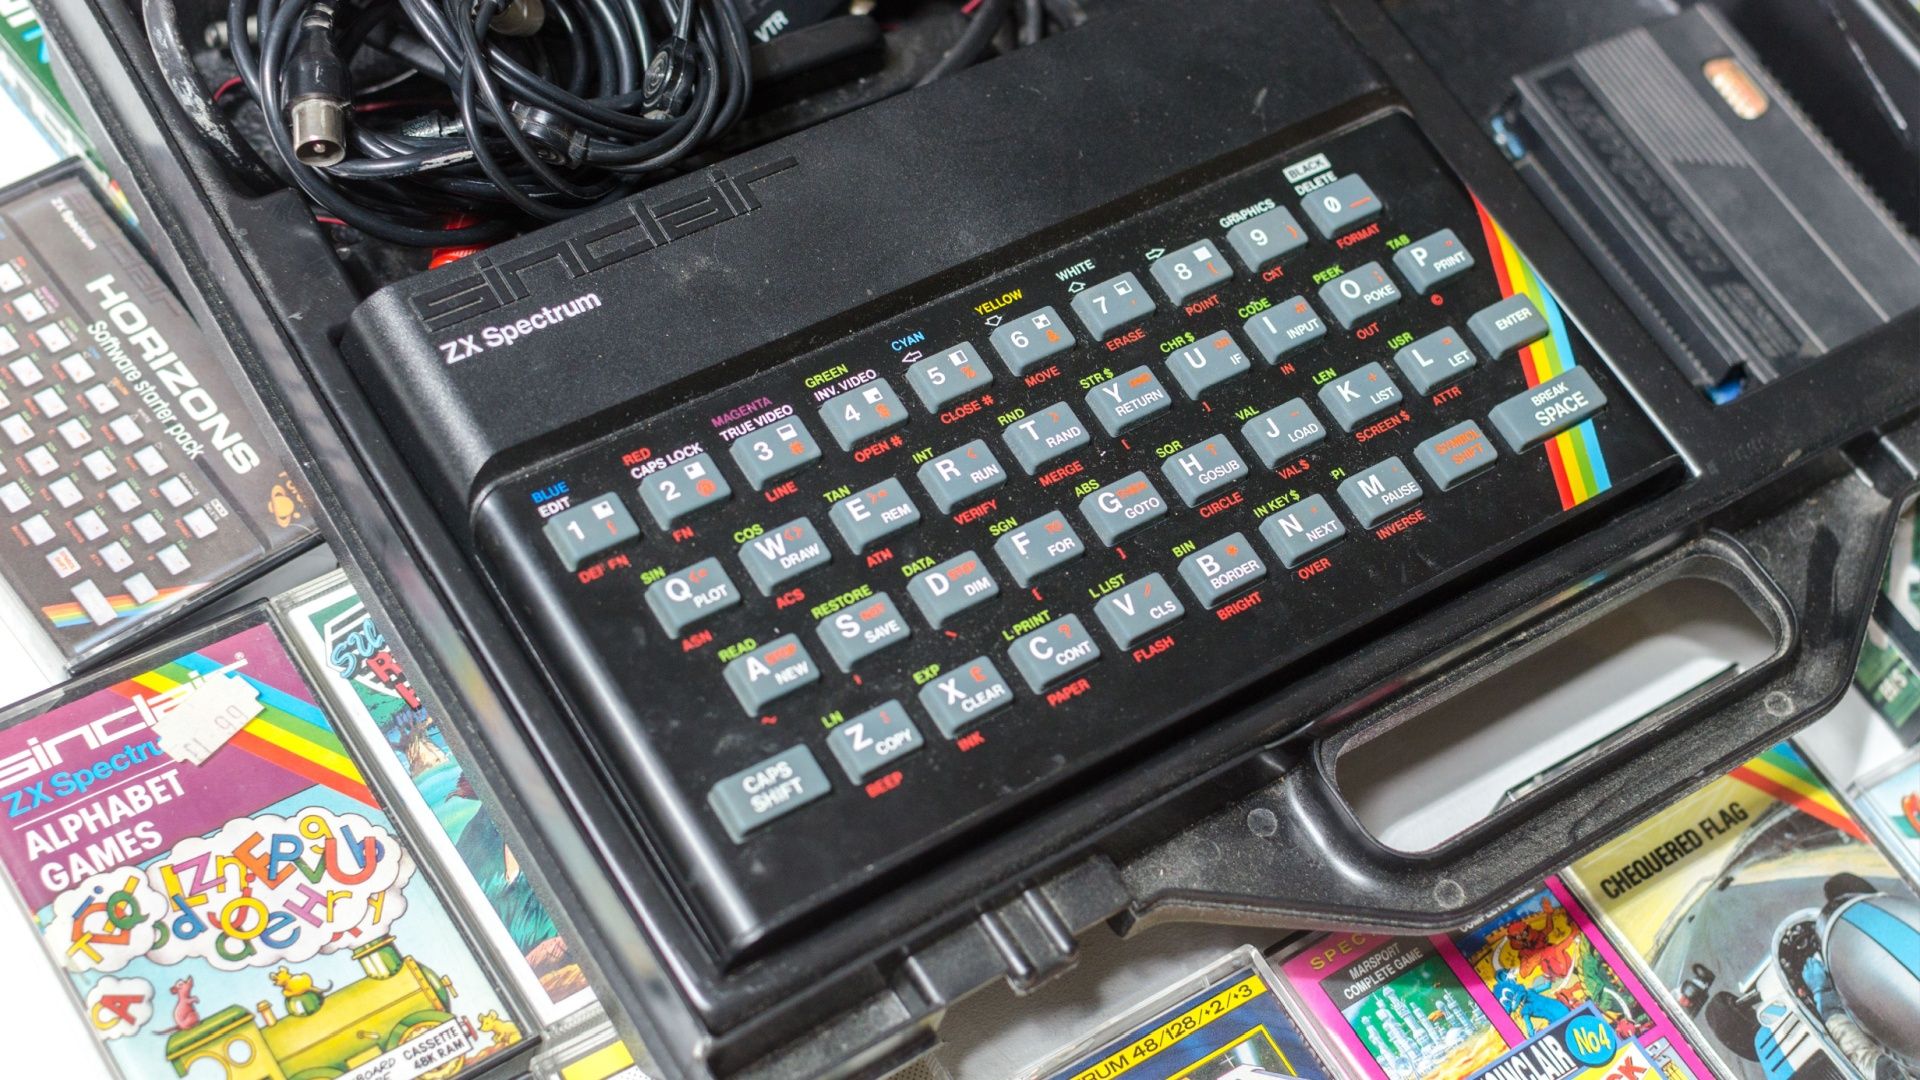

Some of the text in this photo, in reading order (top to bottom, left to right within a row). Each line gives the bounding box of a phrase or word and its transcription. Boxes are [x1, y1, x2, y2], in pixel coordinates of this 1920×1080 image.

[754, 10, 789, 43] VTR
[1287, 158, 1325, 180] BLACK
[1294, 170, 1338, 197] DELETE
[1219, 198, 1276, 228] GRAPHICS
[1250, 228, 1268, 246] 9
[1336, 224, 1381, 250] FORMAT
[1386, 234, 1410, 250] TAB
[1410, 247, 1429, 267] P
[1433, 251, 1467, 273] PRINT
[1055, 258, 1096, 283] WHITE
[1174, 263, 1192, 280] 8
[1262, 266, 1285, 282] CAT
[1312, 264, 1344, 285] PEEK
[974, 289, 1023, 317] YELLOW
[1092, 296, 1109, 315] 7
[1185, 294, 1221, 317] POINT
[1363, 285, 1396, 305] POKE
[1238, 297, 1272, 319] CODE
[1495, 307, 1533, 332] ENTER
[439, 290, 602, 364] ZX Spectrum
[1286, 318, 1320, 340] INPUT
[1356, 322, 1382, 340] OUT
[891, 331, 925, 352] CYAN
[1010, 331, 1029, 348] 6
[1105, 328, 1146, 352] ERASE
[1159, 336, 1183, 354] CHR
[1387, 331, 1414, 350] USR
[1183, 347, 1207, 369] U
[1411, 349, 1434, 368] L
[1448, 350, 1470, 367] LET
[85, 273, 261, 474] HORIZONS
[804, 364, 848, 389] GREEN
[840, 369, 877, 392] VIDEO
[927, 367, 946, 385] 5
[1024, 365, 1061, 388] MOVE
[1079, 372, 1103, 390] STR
[1312, 367, 1337, 386] LEN
[87, 320, 142, 382] Software
[133, 380, 177, 424] starter
[164, 422, 205, 460] pack
[1102, 382, 1120, 404] Y
[1336, 380, 1360, 402] K
[1369, 387, 1395, 405] LIST
[1432, 386, 1463, 406] ATTR
[1530, 381, 1569, 407] BREAK
[710, 396, 772, 428] MAGENTA
[843, 403, 861, 422] 4
[939, 401, 980, 425] CLOSE
[1115, 389, 1164, 417] RETURN
[1234, 405, 1260, 422] VAL
[1535, 391, 1589, 427] SPACE
[719, 404, 793, 442] TRUE VIDEO
[997, 408, 1026, 427] RND
[1019, 419, 1040, 441] T
[1045, 426, 1082, 449] RAND
[1287, 422, 1319, 443] LOAD
[1355, 417, 1400, 444] SCREEN
[622, 447, 651, 466] RED
[630, 442, 703, 479] CAPS LOCK
[753, 441, 774, 461] 3
[853, 440, 889, 464] OPEN
[912, 448, 935, 464] INT
[1155, 440, 1184, 459] SQR
[935, 459, 961, 482] R
[970, 464, 999, 484] RUN
[1039, 460, 1085, 487] MERGE
[1178, 453, 1204, 477] H
[1198, 458, 1241, 486] GOSUB
[531, 481, 569, 504] BLUE
[659, 481, 681, 501] 2
[764, 481, 799, 502] LINE
[823, 485, 851, 503] TAN
[1074, 478, 1100, 497] ABS
[1357, 474, 1385, 499] M
[1381, 481, 1420, 505] PAUSE
[538, 497, 571, 518] EDIT
[845, 499, 871, 522] E
[880, 503, 911, 524] REM
[953, 499, 999, 526] VERIFY
[1098, 492, 1123, 514] G
[1124, 496, 1160, 520] GOTO
[1199, 491, 1244, 519] CIRCLE
[672, 526, 695, 543] FN
[733, 523, 764, 544] COS
[989, 517, 1018, 537] SGN
[1278, 514, 1304, 537] N
[1305, 519, 1338, 542] NEXT
[1375, 509, 1427, 541] INVERSE
[754, 533, 787, 560] W
[1011, 531, 1031, 556] F
[1047, 537, 1075, 558] FOR
[1172, 540, 1196, 558] BIN
[779, 543, 820, 570] DRAW
[865, 548, 894, 569] ATN
[901, 555, 937, 578] DATA
[1196, 554, 1220, 577] B
[640, 567, 666, 585] SIN
[1209, 559, 1260, 590] BORDER
[1297, 557, 1332, 581] OVER
[665, 578, 694, 602] Q
[924, 572, 949, 597] D
[963, 577, 992, 598] DIM
[693, 584, 728, 610] PLOT
[775, 588, 806, 610] ACS
[810, 584, 873, 620] RESTORE
[1112, 593, 1136, 617] V
[1216, 590, 1263, 622] BRIGHT
[1150, 600, 1177, 620] CLS
[835, 614, 860, 639] S
[864, 619, 900, 645] SAVE
[717, 638, 757, 663] READ
[1029, 636, 1053, 660] C
[1055, 640, 1092, 667] CONT
[1132, 635, 1175, 663] FLASH
[745, 657, 772, 683] A
[774, 661, 809, 686] NEW
[912, 663, 940, 685] EXP
[937, 677, 967, 705] X
[960, 683, 1005, 713] CLEAR
[1046, 678, 1092, 708] PAPER
[821, 710, 844, 730] LN
[844, 723, 874, 752] Z
[874, 728, 913, 756] COPY
[3, 736, 166, 818] ZX Spectru
[742, 760, 793, 794] CAPS
[749, 776, 804, 814] SHIFT
[24, 768, 186, 862] ALPHABET
[39, 820, 164, 893] GAMES
[1600, 801, 1750, 900] CHEQUERED FLAG
[1310, 931, 1376, 970] SPEC
[1348, 942, 1402, 980] MARSPORT
[1343, 947, 1425, 1000] COMPLETE GAME
[402, 1026, 459, 1060] CASSETTE
[413, 1054, 438, 1070] 48K
[437, 1039, 465, 1058] RAM
